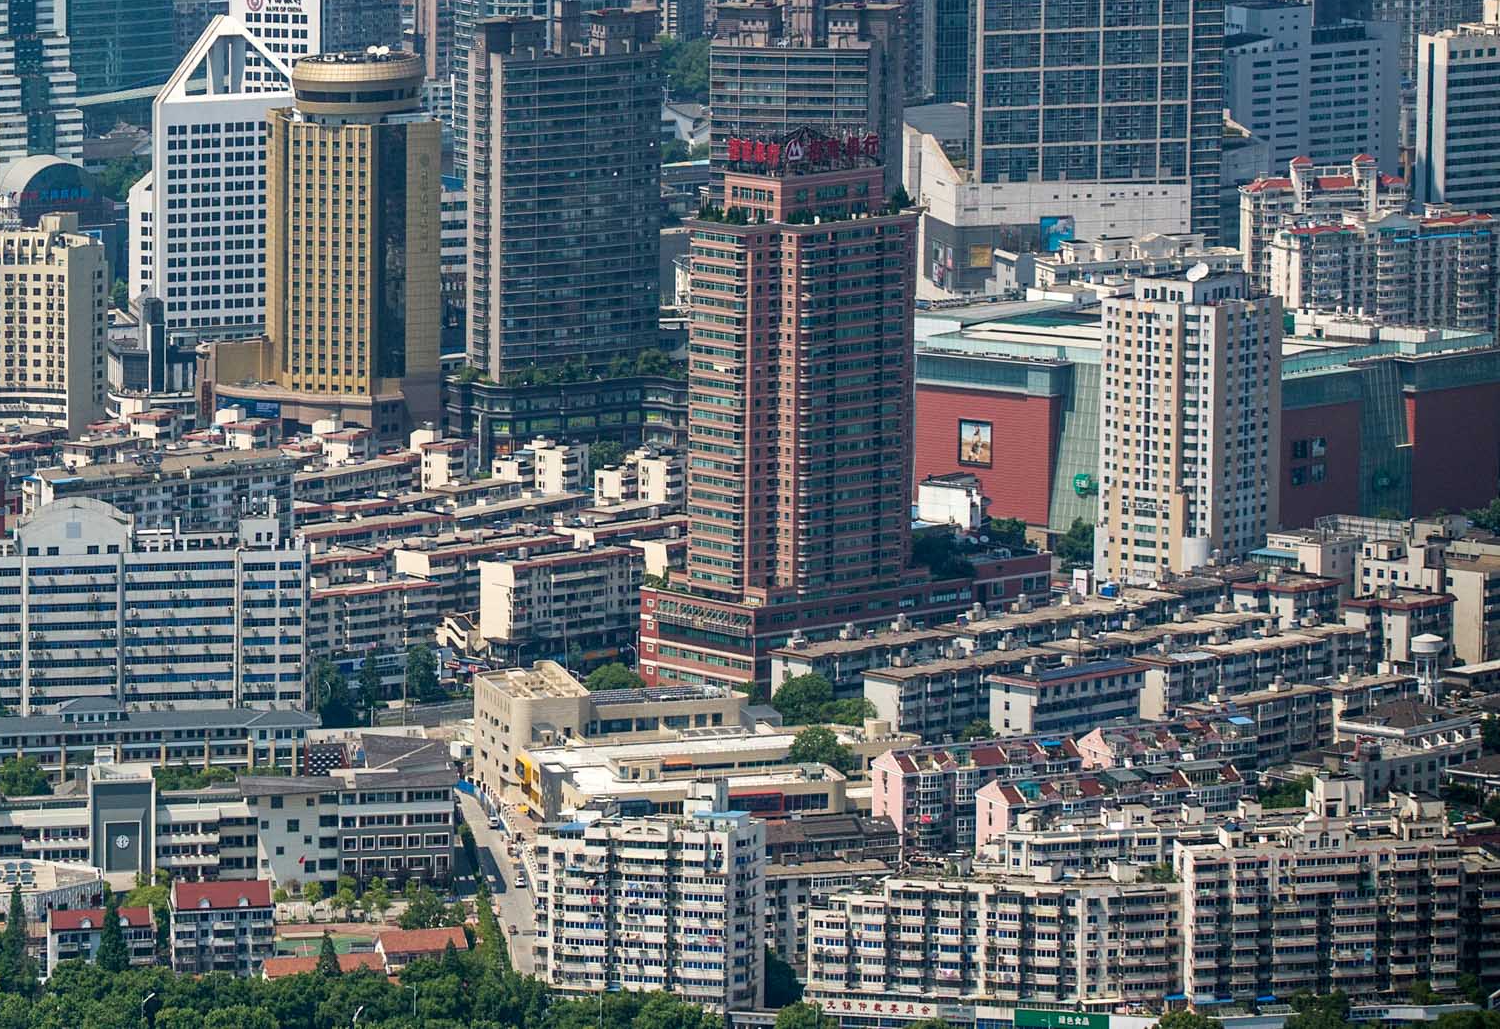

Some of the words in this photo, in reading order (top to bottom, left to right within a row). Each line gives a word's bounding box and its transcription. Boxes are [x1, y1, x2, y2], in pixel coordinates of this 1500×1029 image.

[826, 1000, 931, 1015] 无锡仲裁委员会
